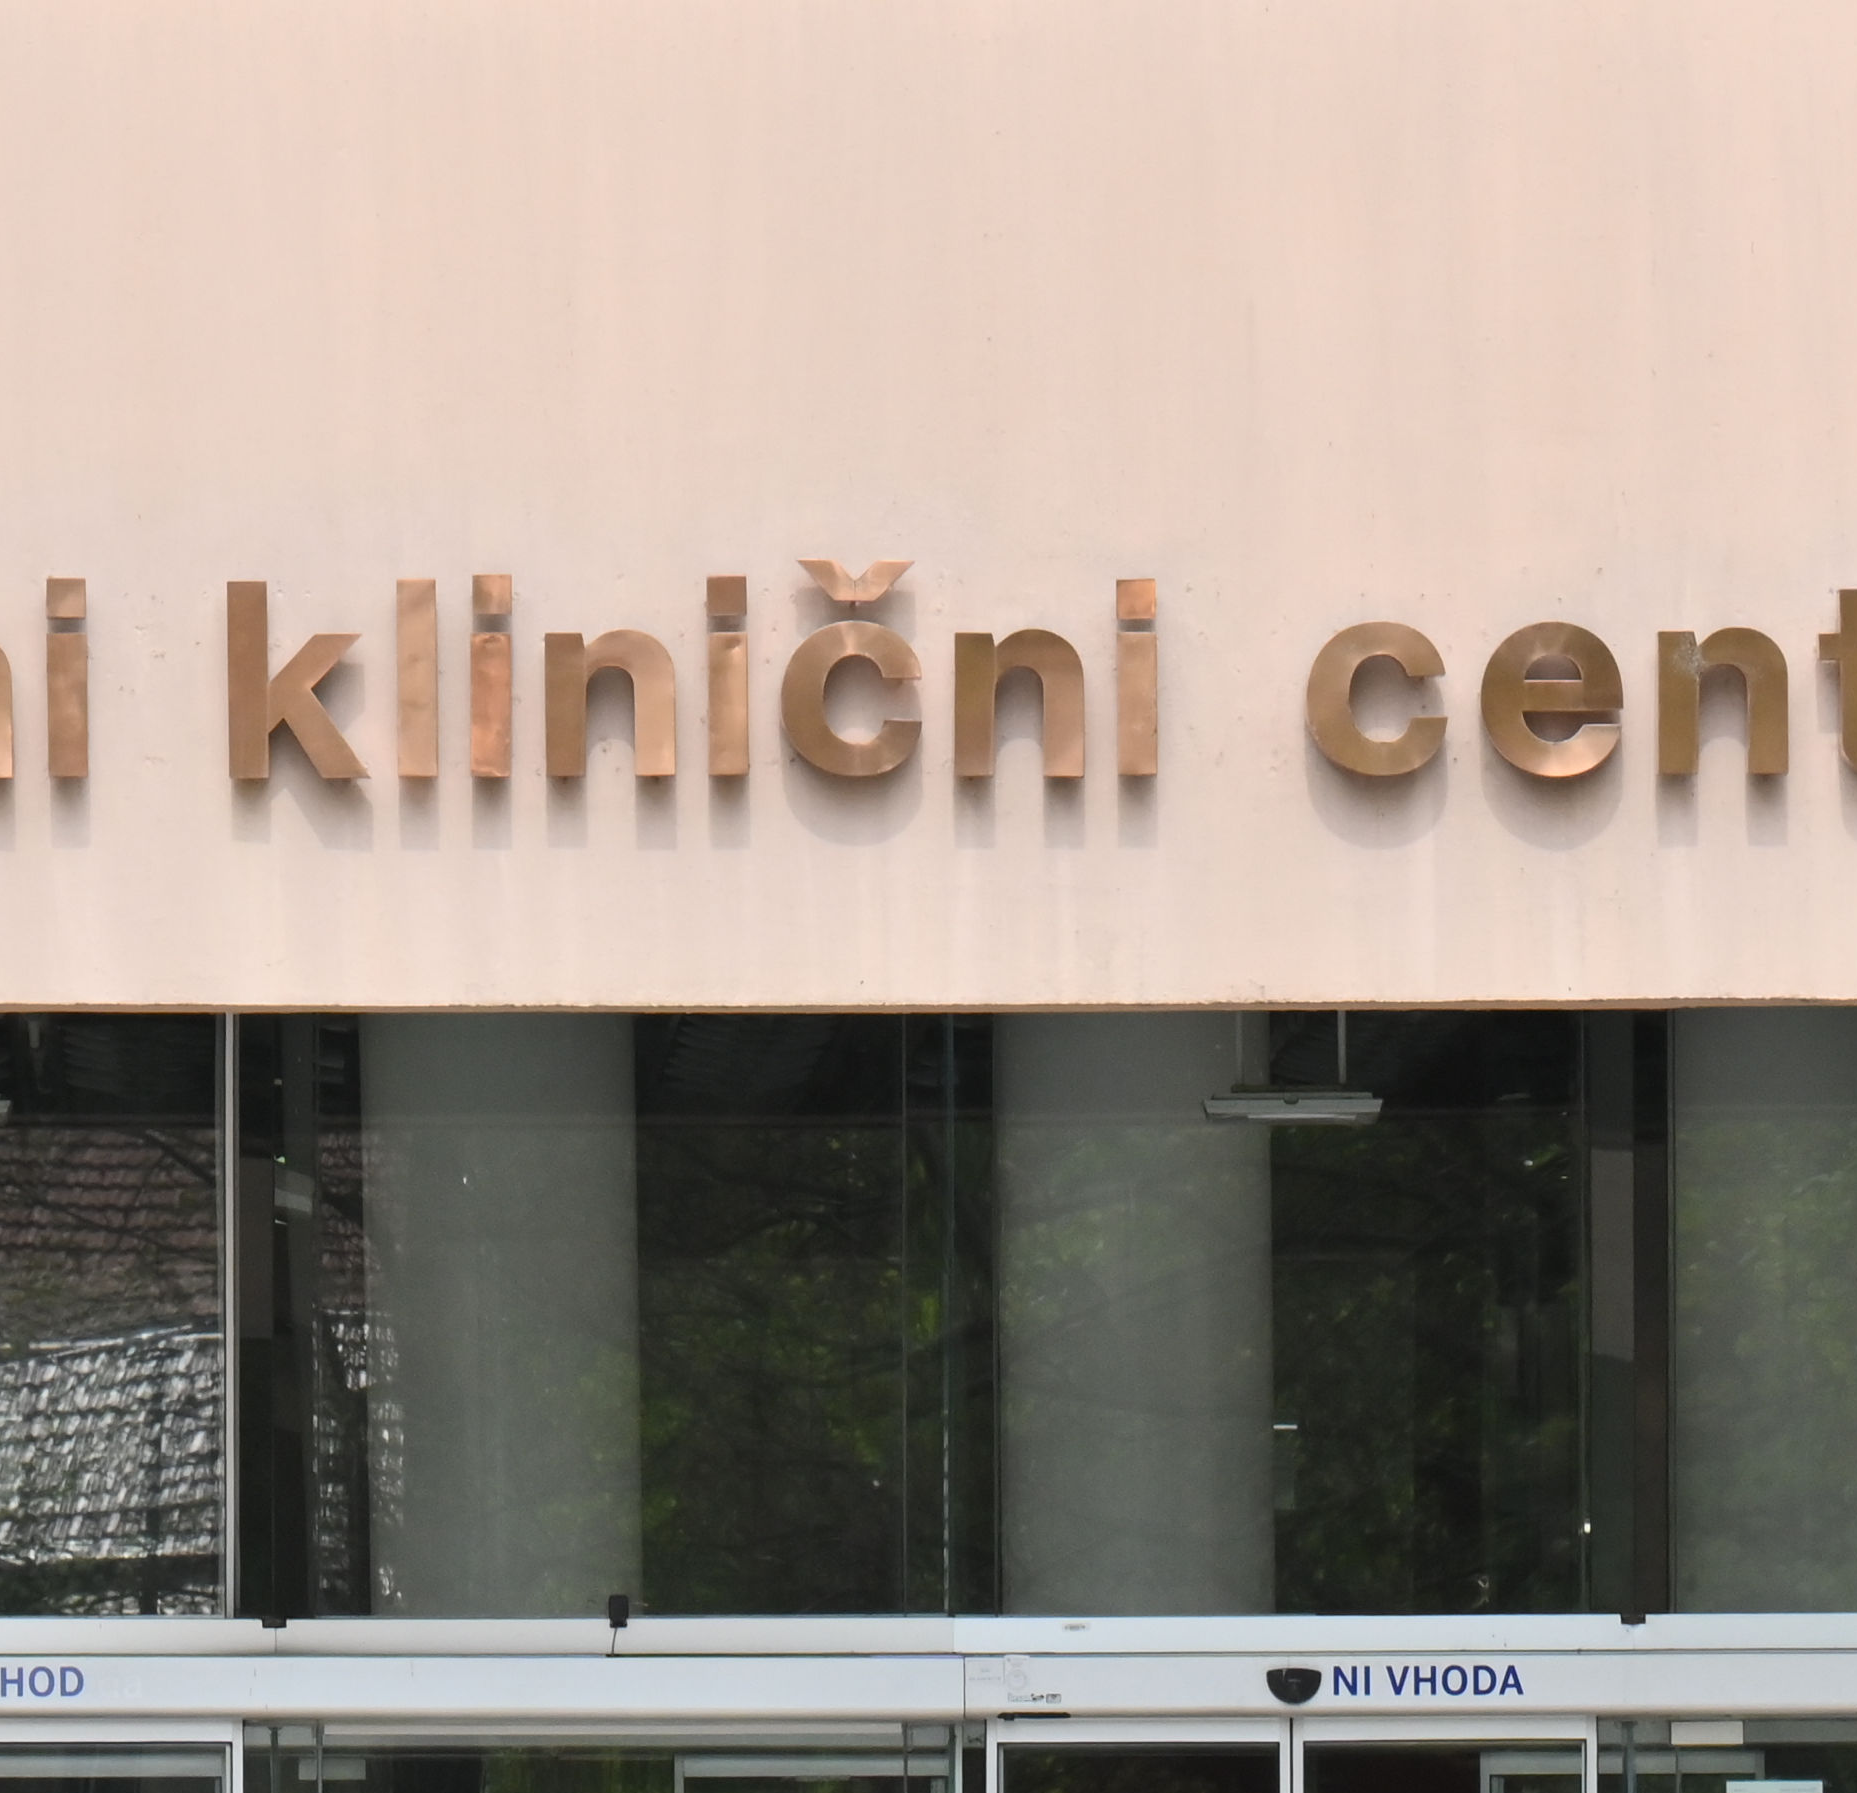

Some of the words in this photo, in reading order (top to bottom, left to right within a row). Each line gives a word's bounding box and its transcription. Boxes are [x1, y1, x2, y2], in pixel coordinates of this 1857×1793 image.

[227, 559, 1158, 779] klinični
[1333, 1665, 1371, 1696] NI
[1386, 1665, 1524, 1696] VHODA
